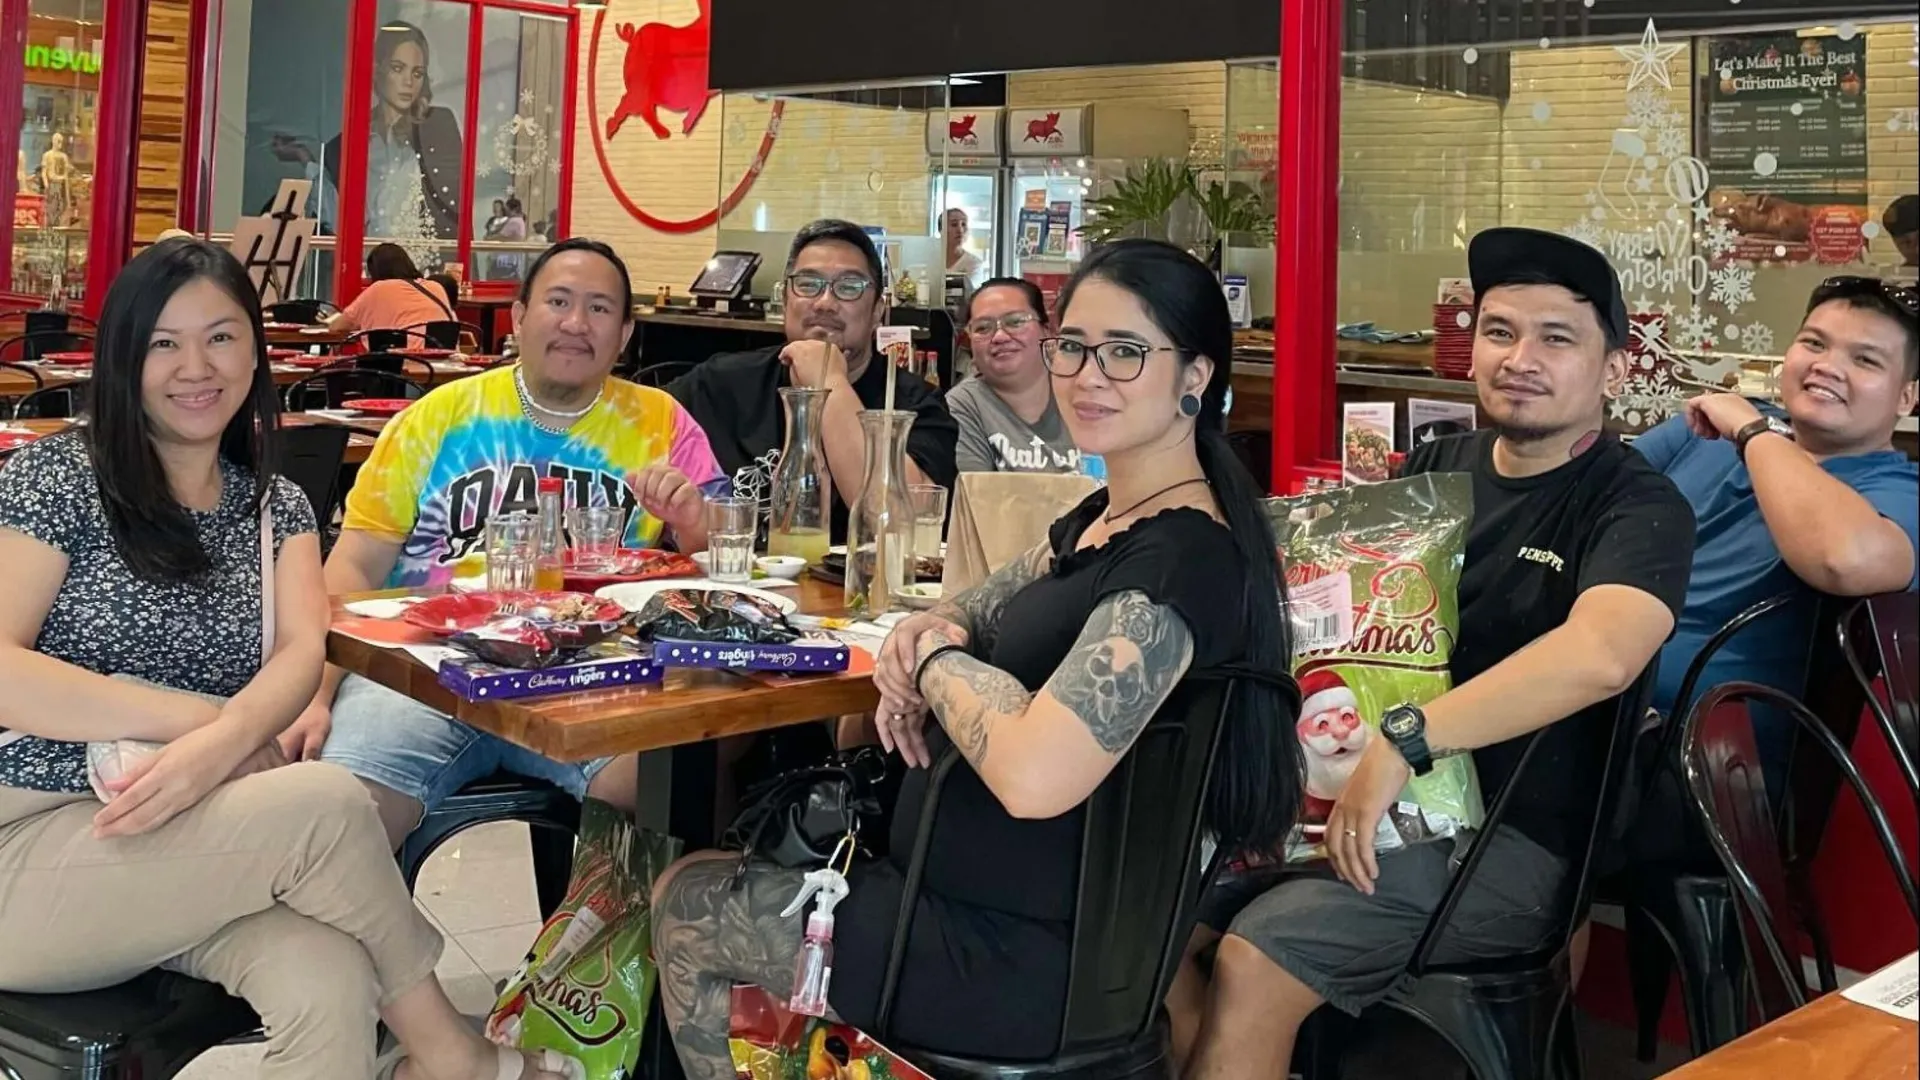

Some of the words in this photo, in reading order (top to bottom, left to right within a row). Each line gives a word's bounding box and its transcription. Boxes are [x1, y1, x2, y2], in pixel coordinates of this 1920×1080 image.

[1714, 57, 1743, 71] Let's
[1746, 56, 1782, 70] Make
[1785, 54, 1796, 68] It
[1798, 52, 1825, 67] The
[1827, 50, 1857, 65] Best
[1732, 74, 1798, 91] Christmas
[1801, 73, 1838, 88] Ever!
[758, 650, 797, 667] Cadbury
[528, 673, 567, 689] Cadbury
